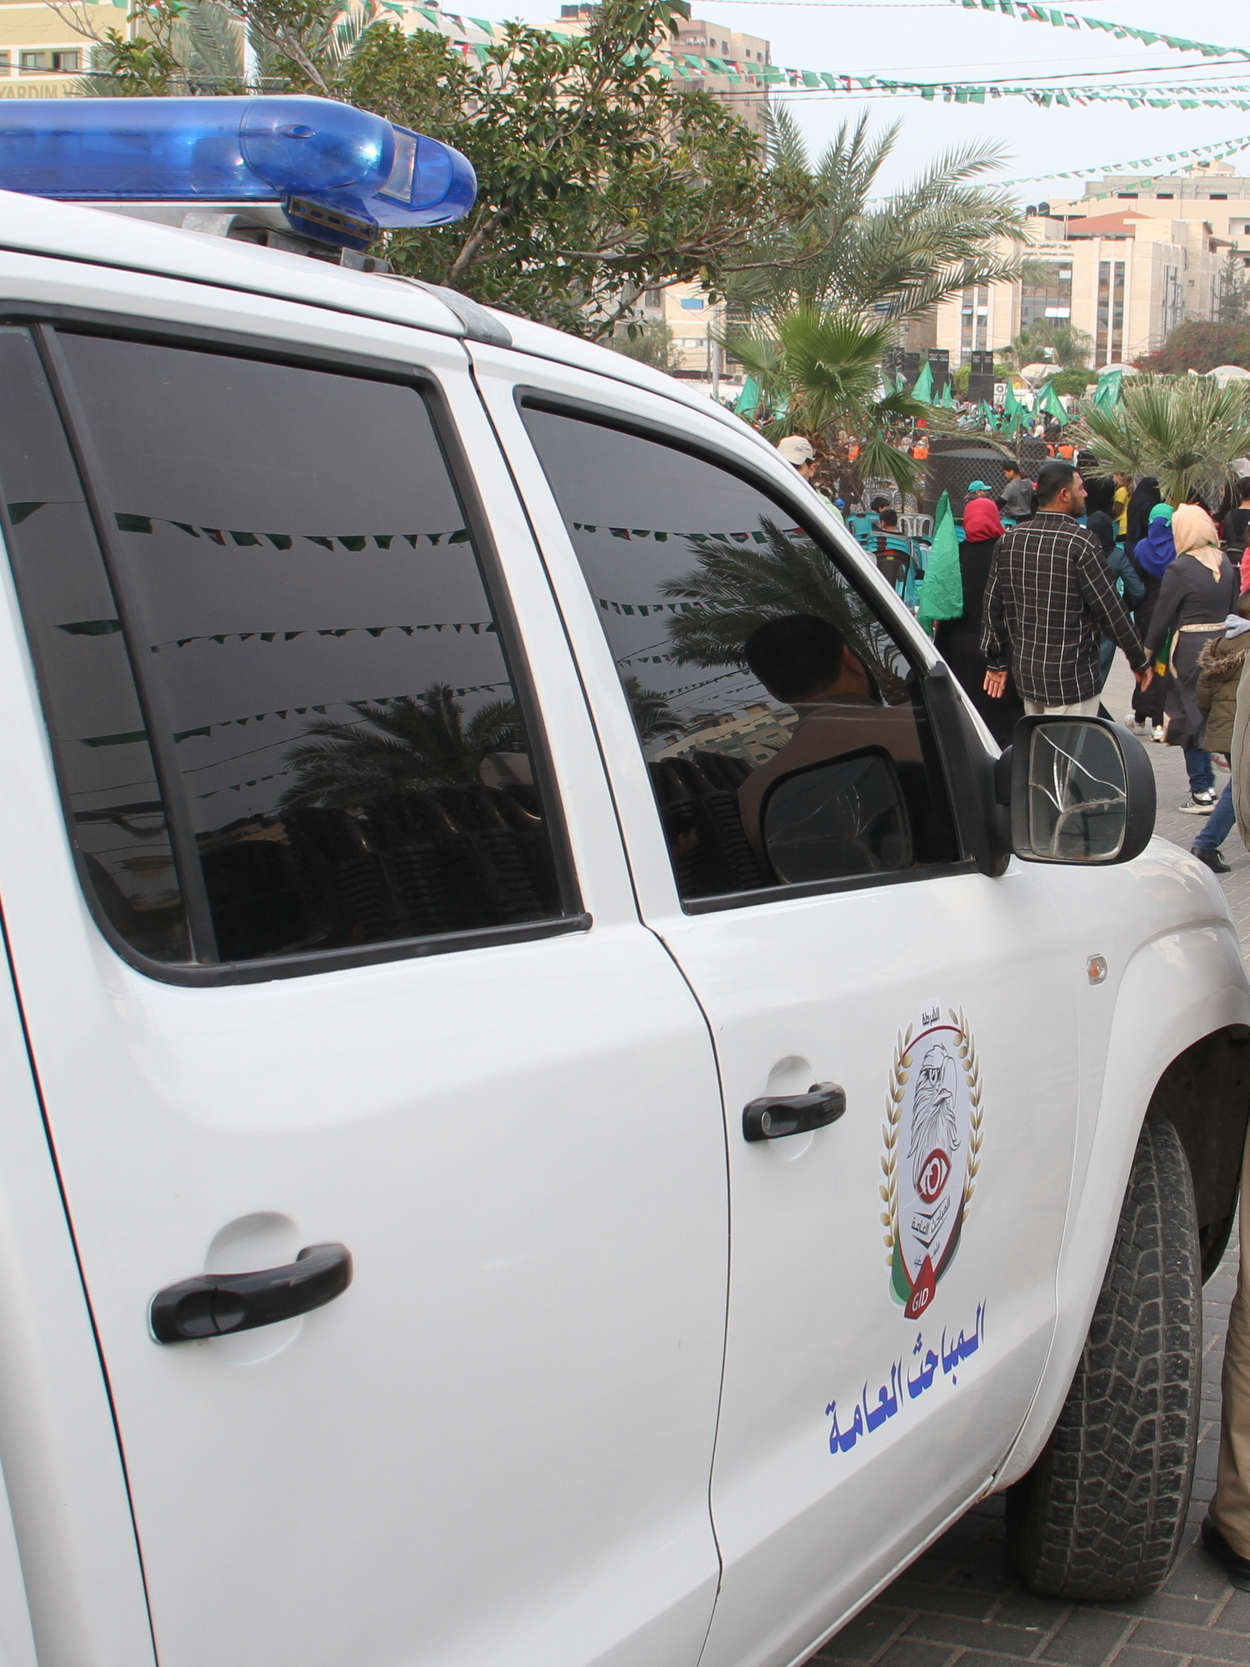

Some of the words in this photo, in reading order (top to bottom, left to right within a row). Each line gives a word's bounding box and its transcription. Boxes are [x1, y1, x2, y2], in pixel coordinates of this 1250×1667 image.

[921, 1006, 940, 1026] الشرطة
[911, 1216, 930, 1236] العامة
[931, 1195, 951, 1233] المباحث
[907, 1297, 987, 1399] المباحث
[825, 1356, 904, 1455] العامة
